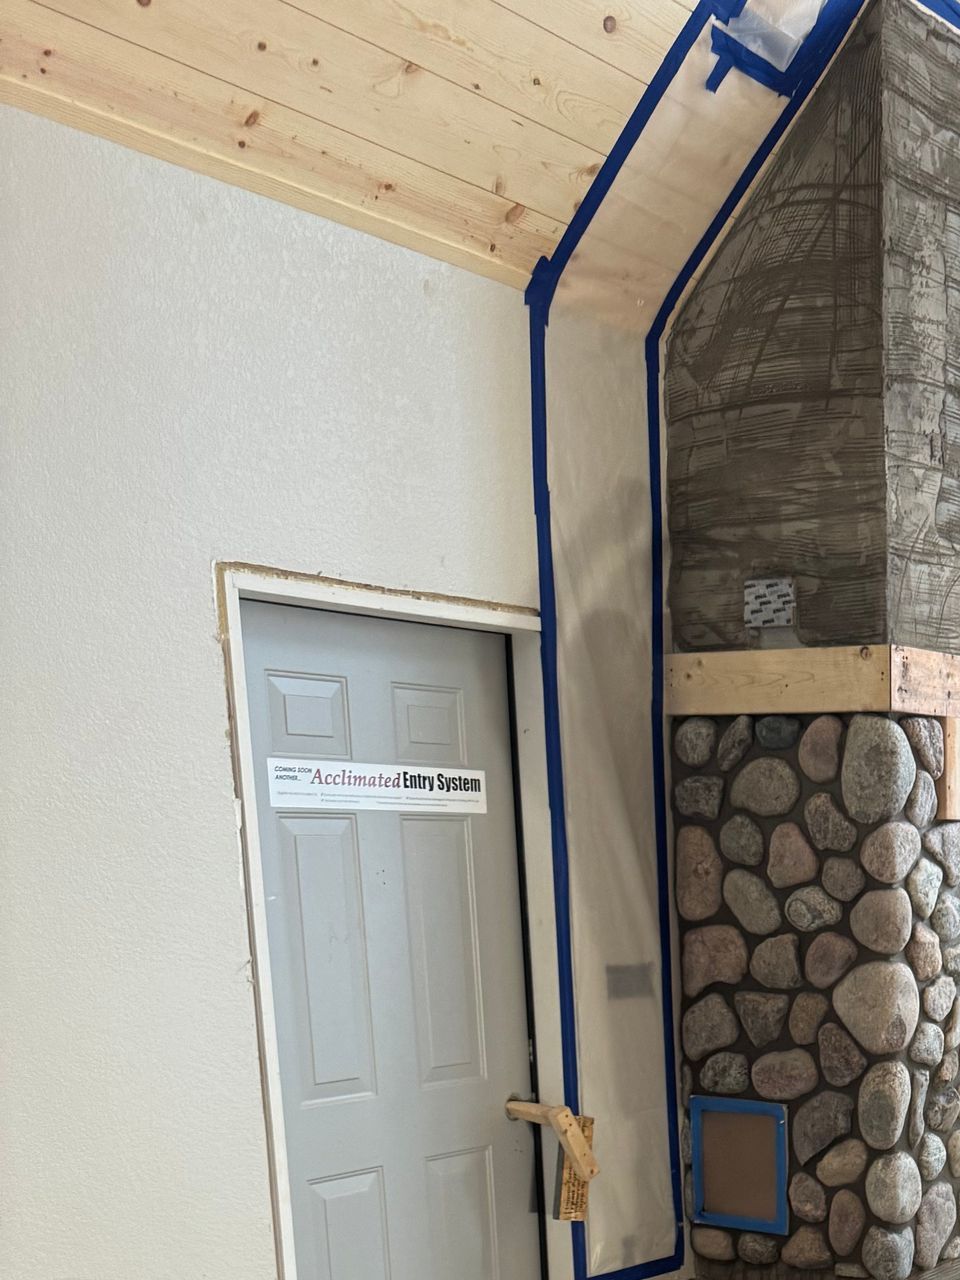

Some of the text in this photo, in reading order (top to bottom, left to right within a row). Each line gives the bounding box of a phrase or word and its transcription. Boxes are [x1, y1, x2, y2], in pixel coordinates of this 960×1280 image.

[310, 768, 481, 792] Acclimated Entry System
